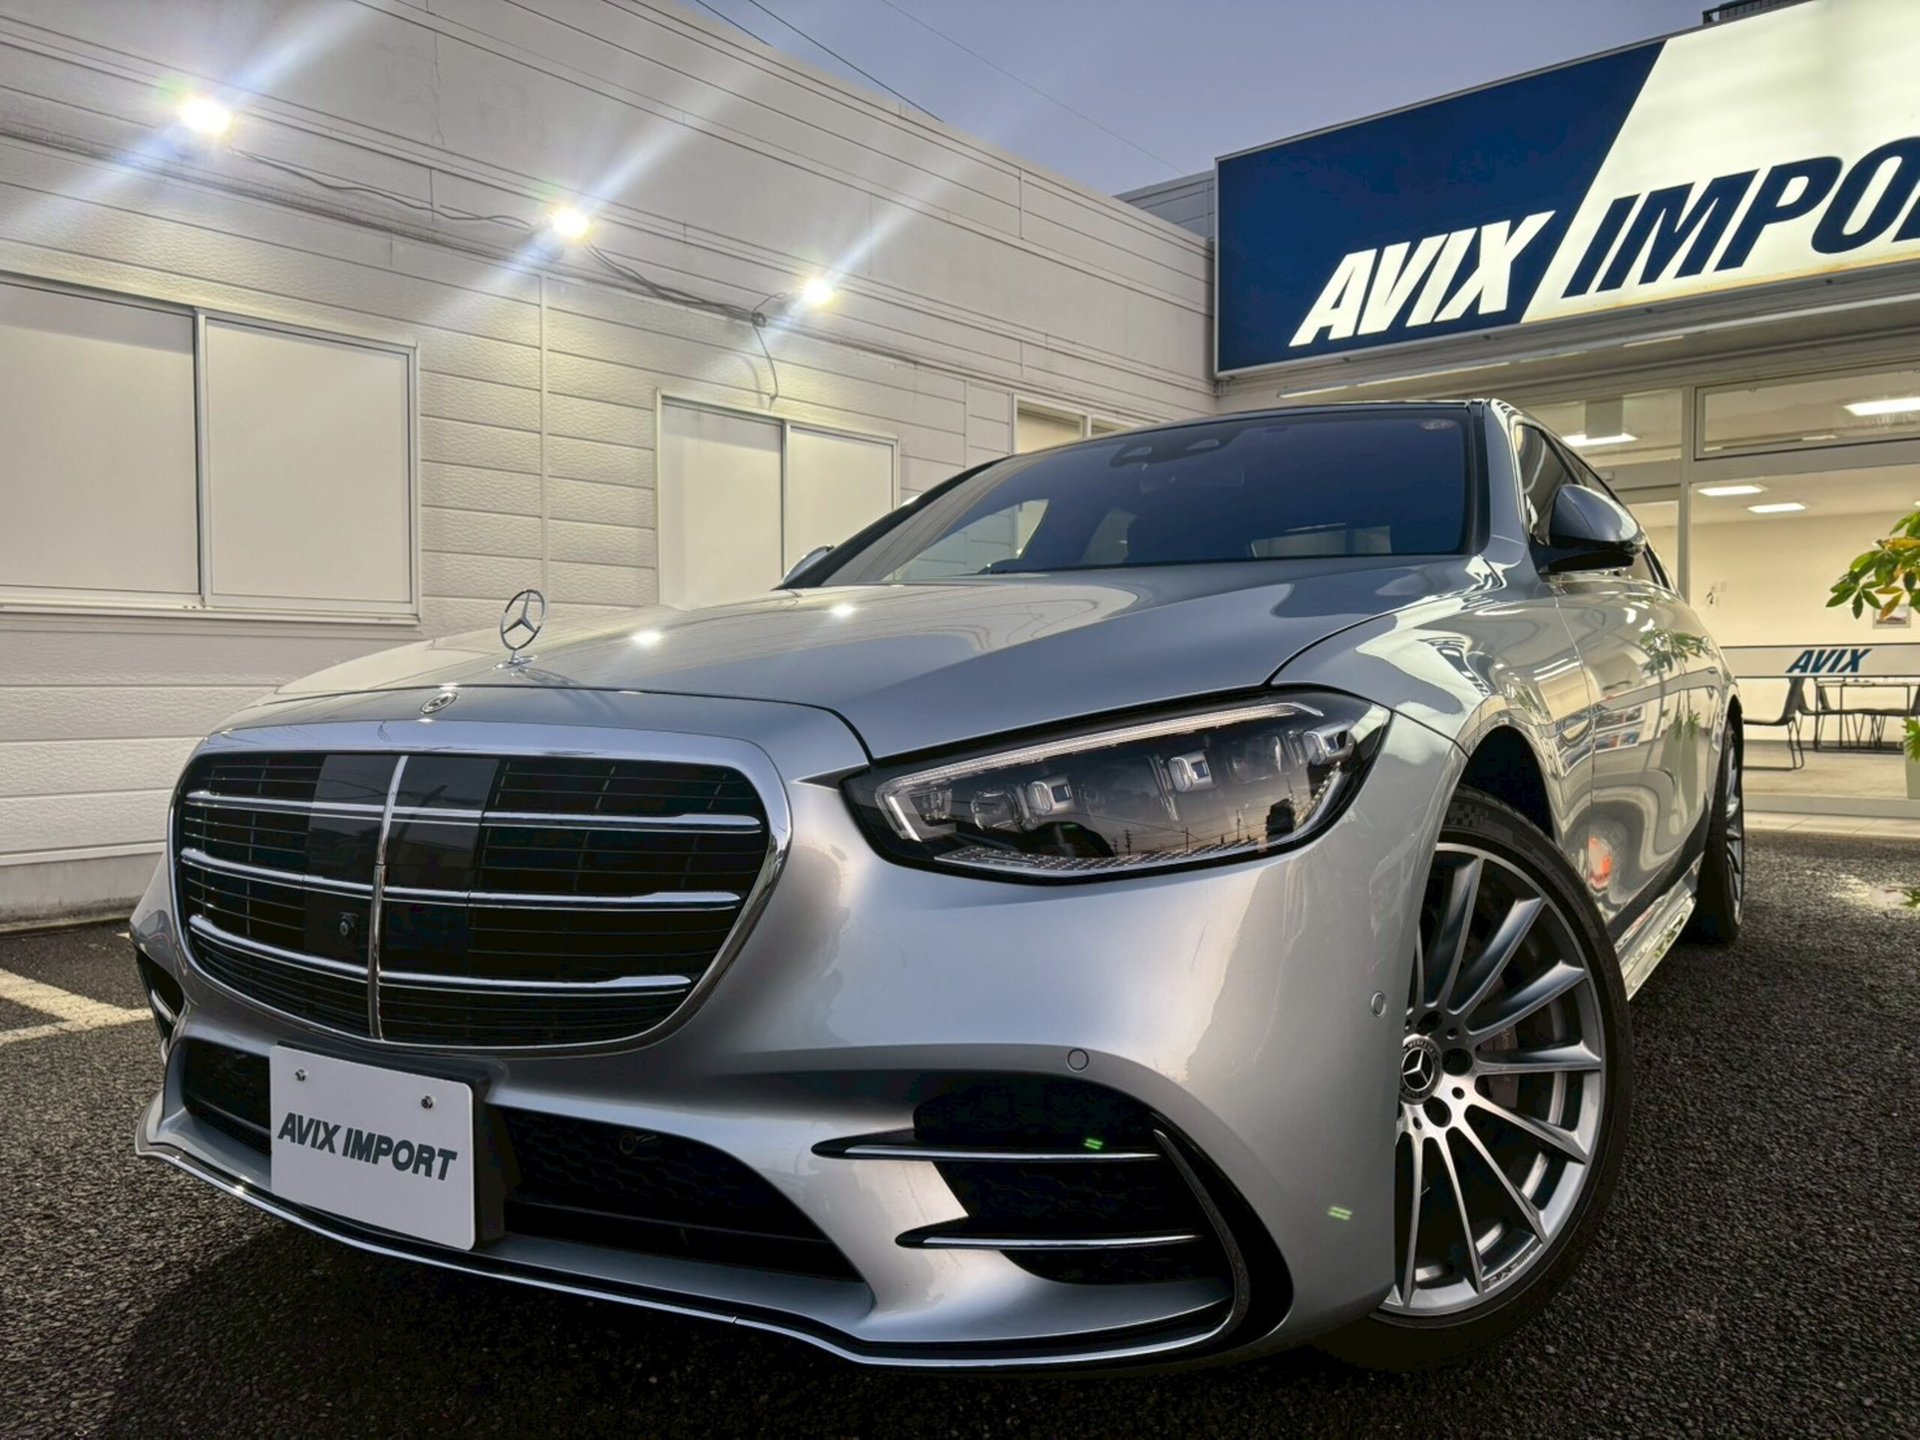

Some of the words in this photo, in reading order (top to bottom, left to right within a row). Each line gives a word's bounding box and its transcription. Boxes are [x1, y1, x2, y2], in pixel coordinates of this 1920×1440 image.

[1288, 209, 1556, 347] AVIX
[1784, 648, 1873, 674] AVIX
[277, 1111, 341, 1154] AVIX
[341, 1127, 458, 1181] IMPORT
